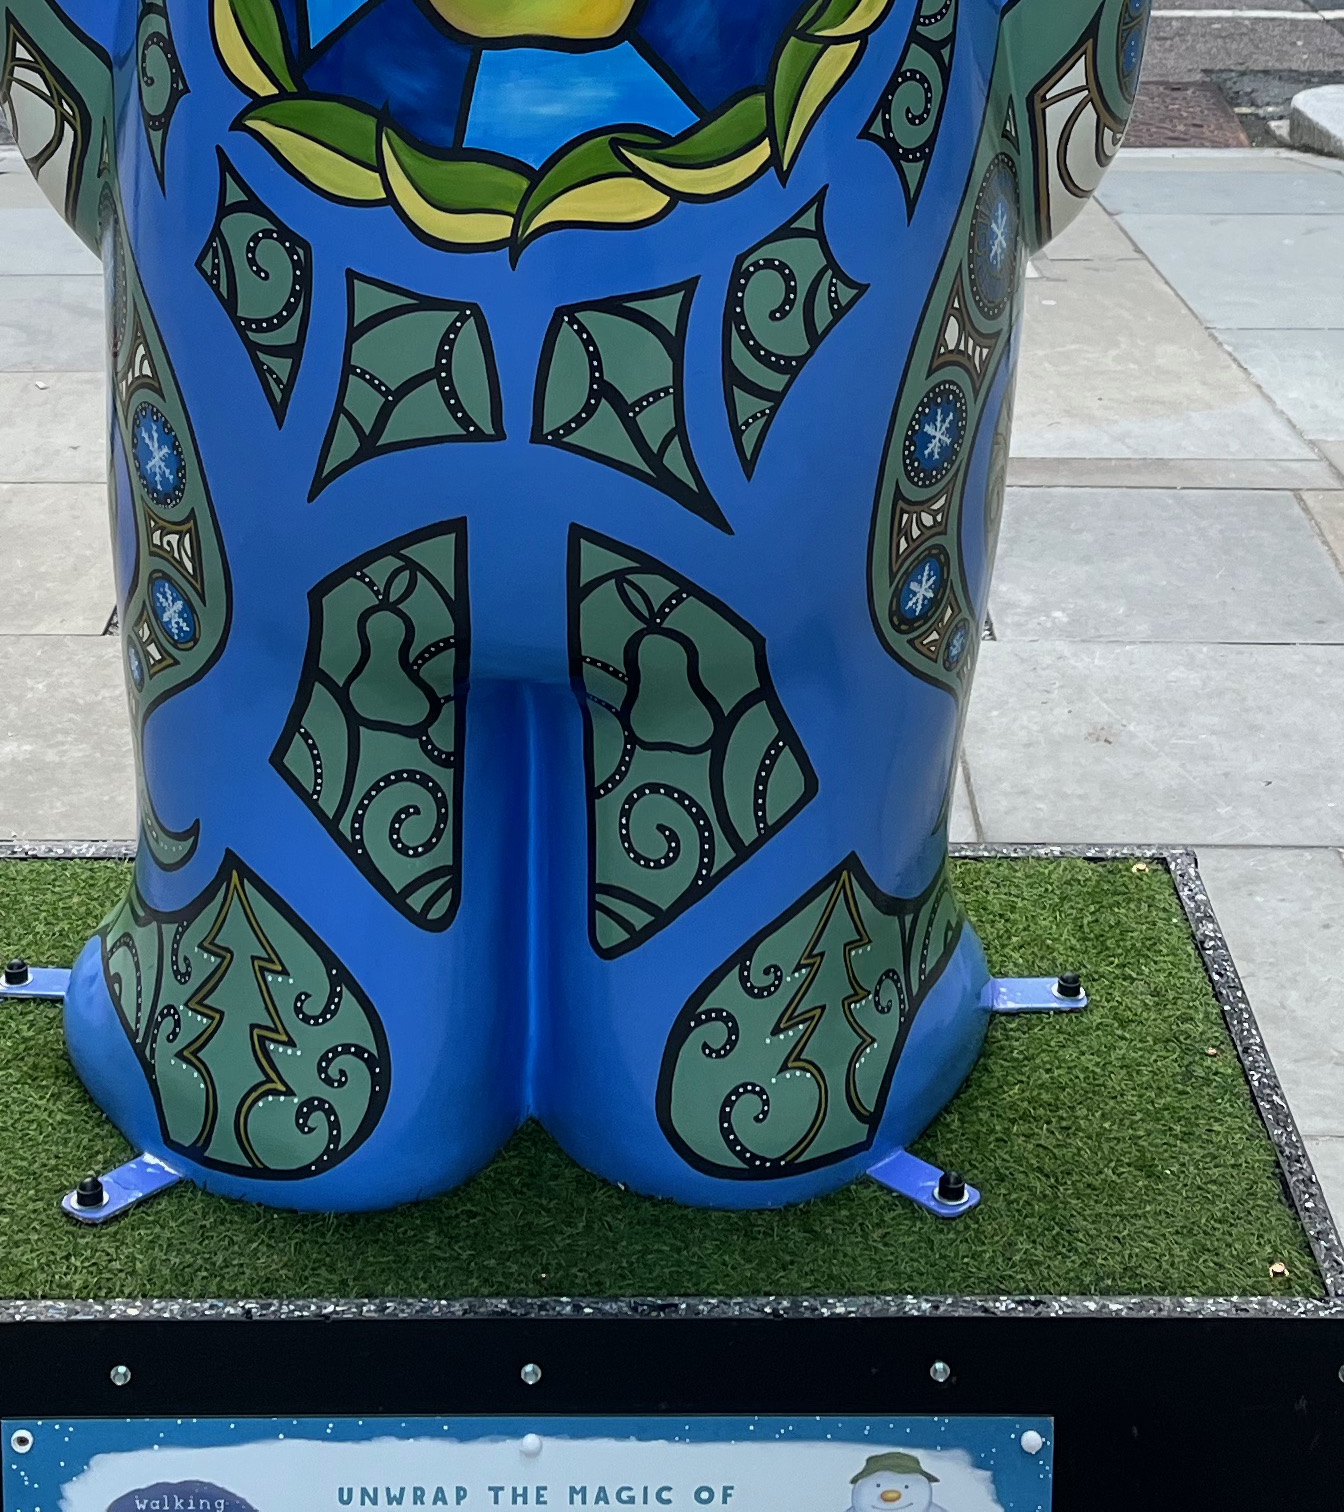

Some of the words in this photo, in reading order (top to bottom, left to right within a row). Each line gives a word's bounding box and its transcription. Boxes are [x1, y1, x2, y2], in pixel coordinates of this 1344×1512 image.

[134, 1495, 225, 1512] walking
[337, 1486, 468, 1506] UNWRAP
[487, 1485, 548, 1505] THE
[568, 1485, 673, 1506] MAGIC
[693, 1485, 735, 1506] OF
